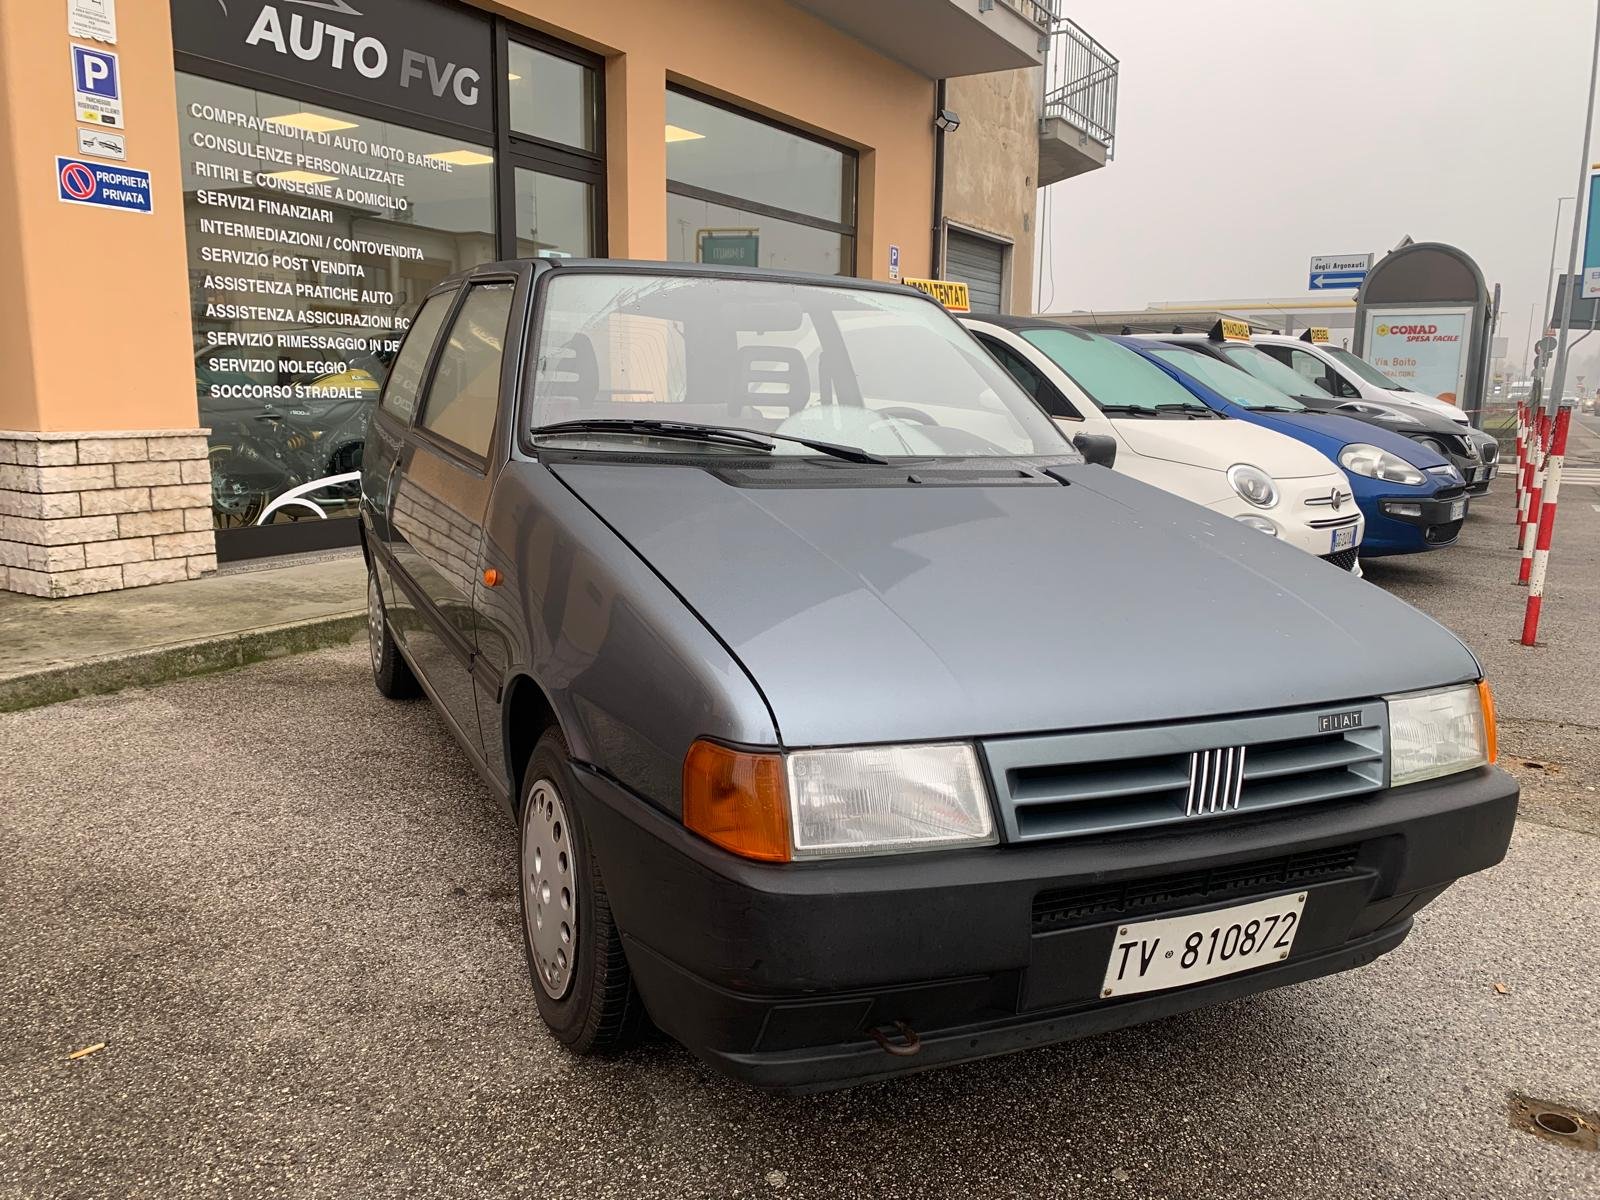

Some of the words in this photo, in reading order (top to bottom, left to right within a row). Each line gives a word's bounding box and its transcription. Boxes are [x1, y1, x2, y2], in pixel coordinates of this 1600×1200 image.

[245, 5, 388, 79] AUTO
[400, 48, 480, 106] FVG
[84, 54, 108, 89] P
[191, 103, 315, 143] COMPRAVENDITA
[317, 131, 331, 147] DI
[333, 134, 368, 154] AUTO
[370, 143, 405, 162] MOTO
[407, 152, 452, 173] BARCHE
[193, 132, 293, 165] CONSULENZE
[296, 153, 405, 186] PERSONALIZZATE
[96, 171, 149, 189] PROPRIETA'
[195, 161, 239, 182] RITIRI
[242, 169, 253, 184] E
[255, 172, 332, 198] CONSEGNE
[335, 187, 344, 199] A
[347, 189, 408, 210] DOMICILIO
[103, 188, 145, 204] PRIVATA
[197, 190, 254, 211] SERVIZI
[258, 199, 333, 223] FINANZIARI
[200, 219, 323, 247] INTERMEDIAZIONI
[326, 236, 331, 248] /
[333, 238, 424, 260] CONTOVENDITA
[201, 247, 268, 266] SERVIZIO
[273, 255, 308, 271] POST
[312, 260, 365, 277] VENDITA
[892, 248, 898, 265] P
[1314, 263, 1330, 271] degli
[1333, 261, 1365, 270] Argonauti
[204, 275, 293, 295] ASSISTENZA
[296, 284, 358, 301] PRATICHE
[361, 292, 393, 305] AUTO
[206, 304, 294, 322] ASSISTENZA
[297, 310, 392, 328] ASSICURAZIONI
[207, 331, 273, 347] SERVIZIO
[277, 334, 366, 351] RIMESSAGGIO
[369, 339, 381, 352] IN
[384, 340, 401, 352] DE
[1390, 325, 1437, 335] CONAD
[209, 358, 275, 372] SERVIZIO
[279, 360, 347, 374] NOLEGGIO
[1375, 357, 1388, 366] Via
[1392, 357, 1416, 367] Boito
[210, 384, 291, 398] SOCCORSO
[295, 386, 362, 399] STRADALE
[1321, 711, 1362, 730] FIAT
[1117, 937, 1160, 981] TV
[1180, 911, 1298, 970] 810872
